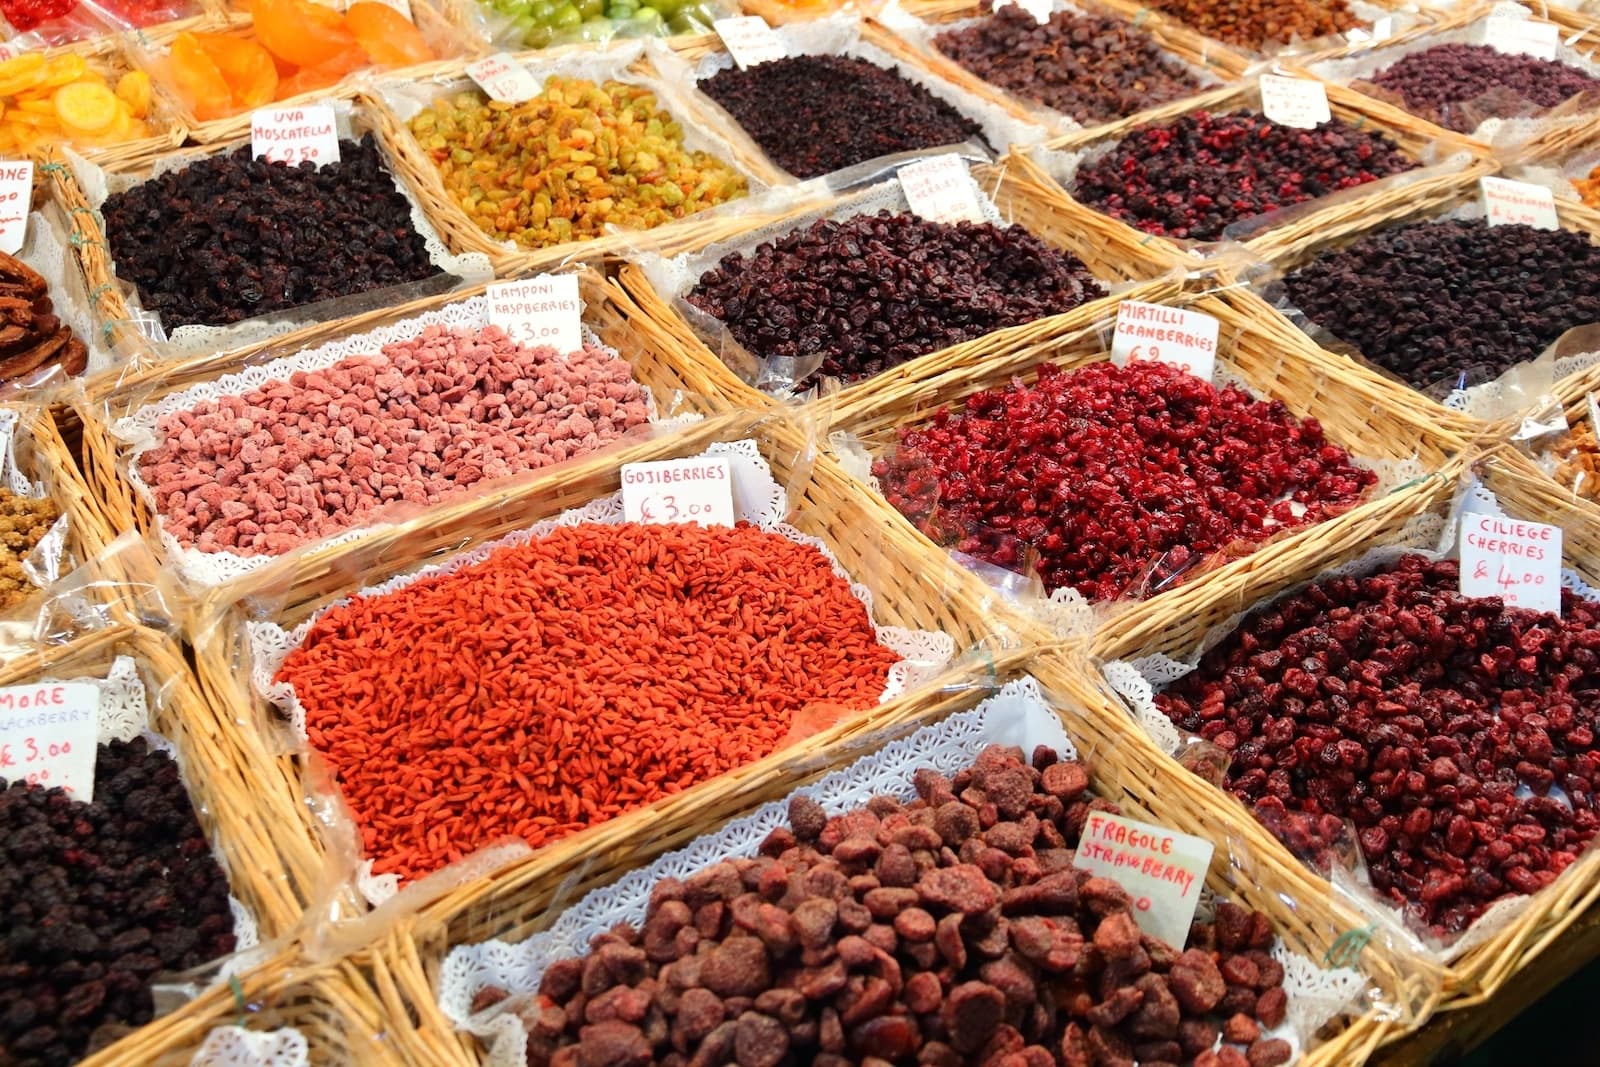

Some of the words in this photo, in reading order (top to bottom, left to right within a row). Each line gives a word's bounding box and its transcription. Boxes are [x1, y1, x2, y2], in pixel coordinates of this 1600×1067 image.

[274, 111, 304, 123] UVA
[254, 124, 332, 141] MOSCATELLA
[492, 284, 553, 300] LAMPONI
[495, 300, 576, 316] RASPBERRIES
[1119, 302, 1185, 326] MIRTILLI
[521, 322, 559, 341] 3.00
[1117, 321, 1214, 352] CRANBERRIES
[624, 465, 725, 484] GOJIBERRIES
[663, 496, 712, 520] 3.00
[1480, 519, 1553, 541] CILIEGE
[1467, 533, 1544, 561] CHERRIES
[1497, 564, 1545, 590] 4.00
[0, 687, 65, 709] MORE
[24, 737, 72, 761] 3.00
[1090, 817, 1174, 854] FRAGOLE
[1082, 841, 1195, 897] STRAWBERRY
